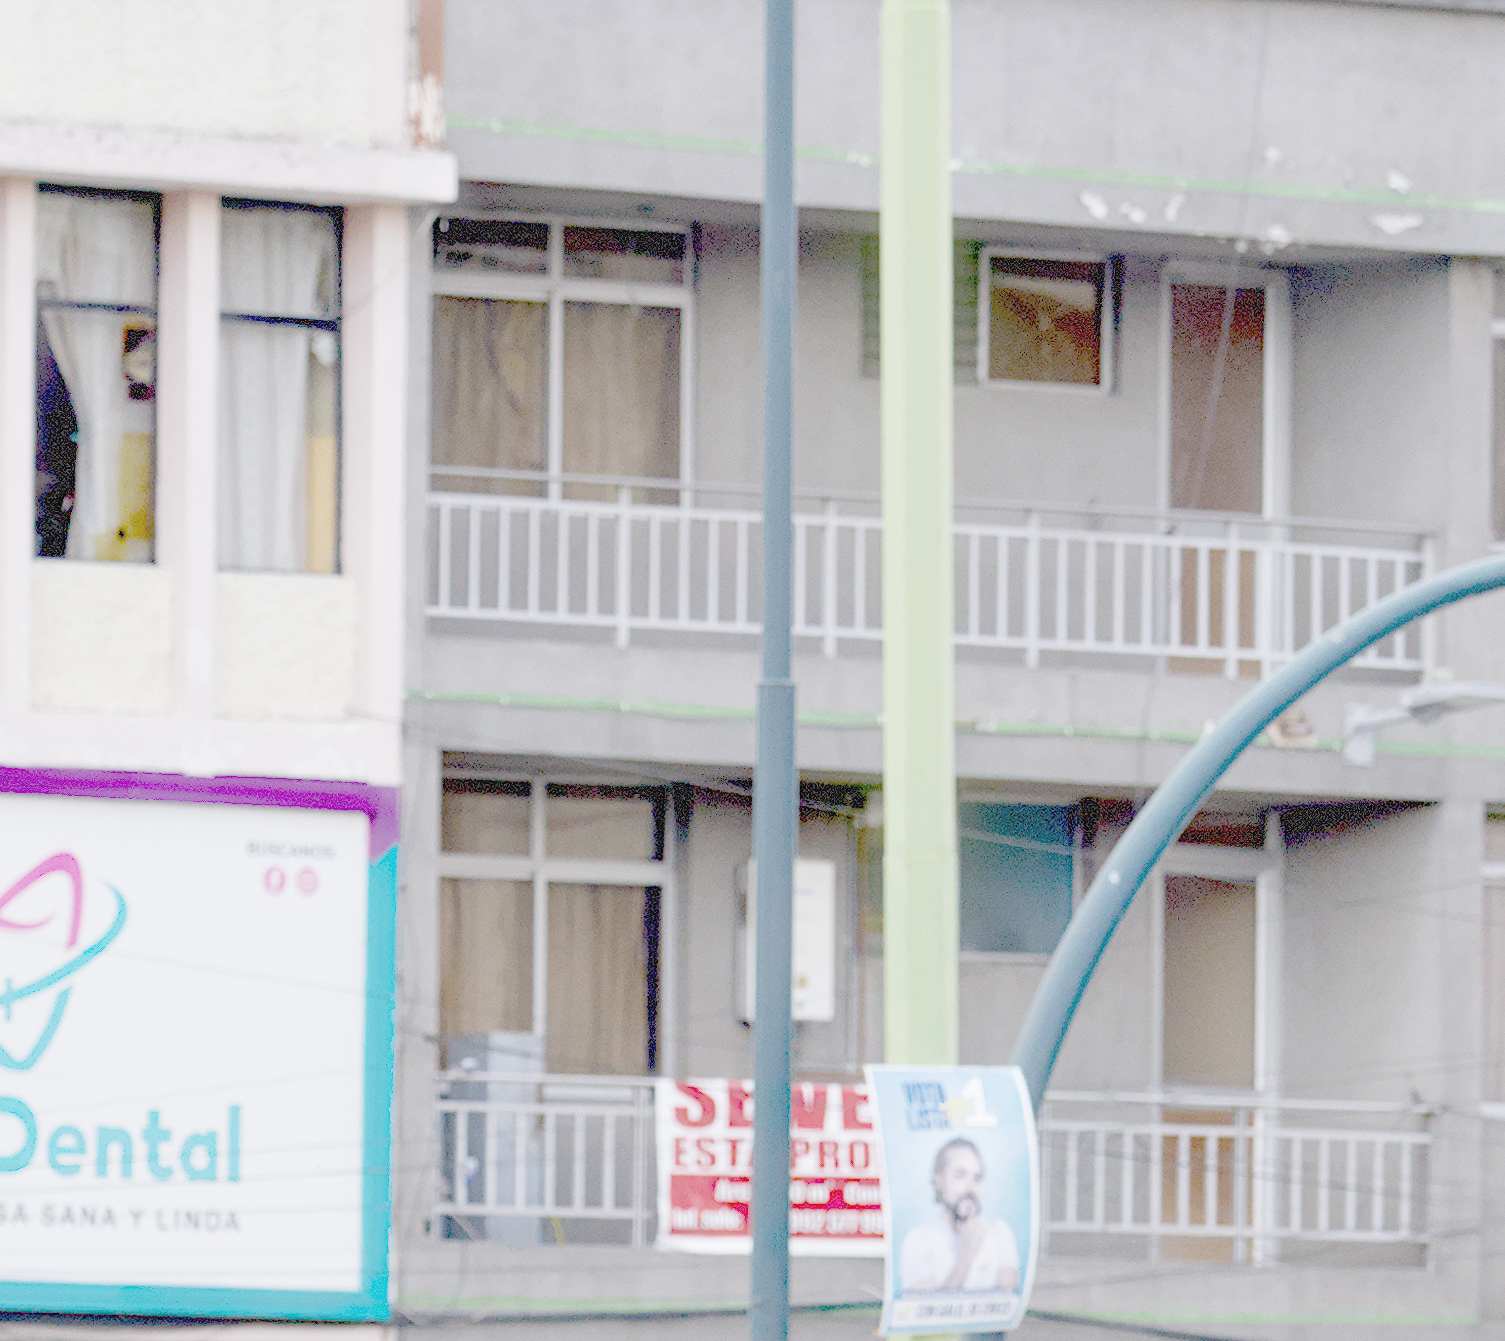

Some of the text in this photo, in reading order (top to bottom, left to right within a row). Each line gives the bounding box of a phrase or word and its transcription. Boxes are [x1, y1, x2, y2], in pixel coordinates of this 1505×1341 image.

[674, 1138, 871, 1172] EST PRO
[41, 1206, 118, 1232] SANA
[127, 1209, 147, 1232] Y
[155, 1209, 241, 1234] LINDA
